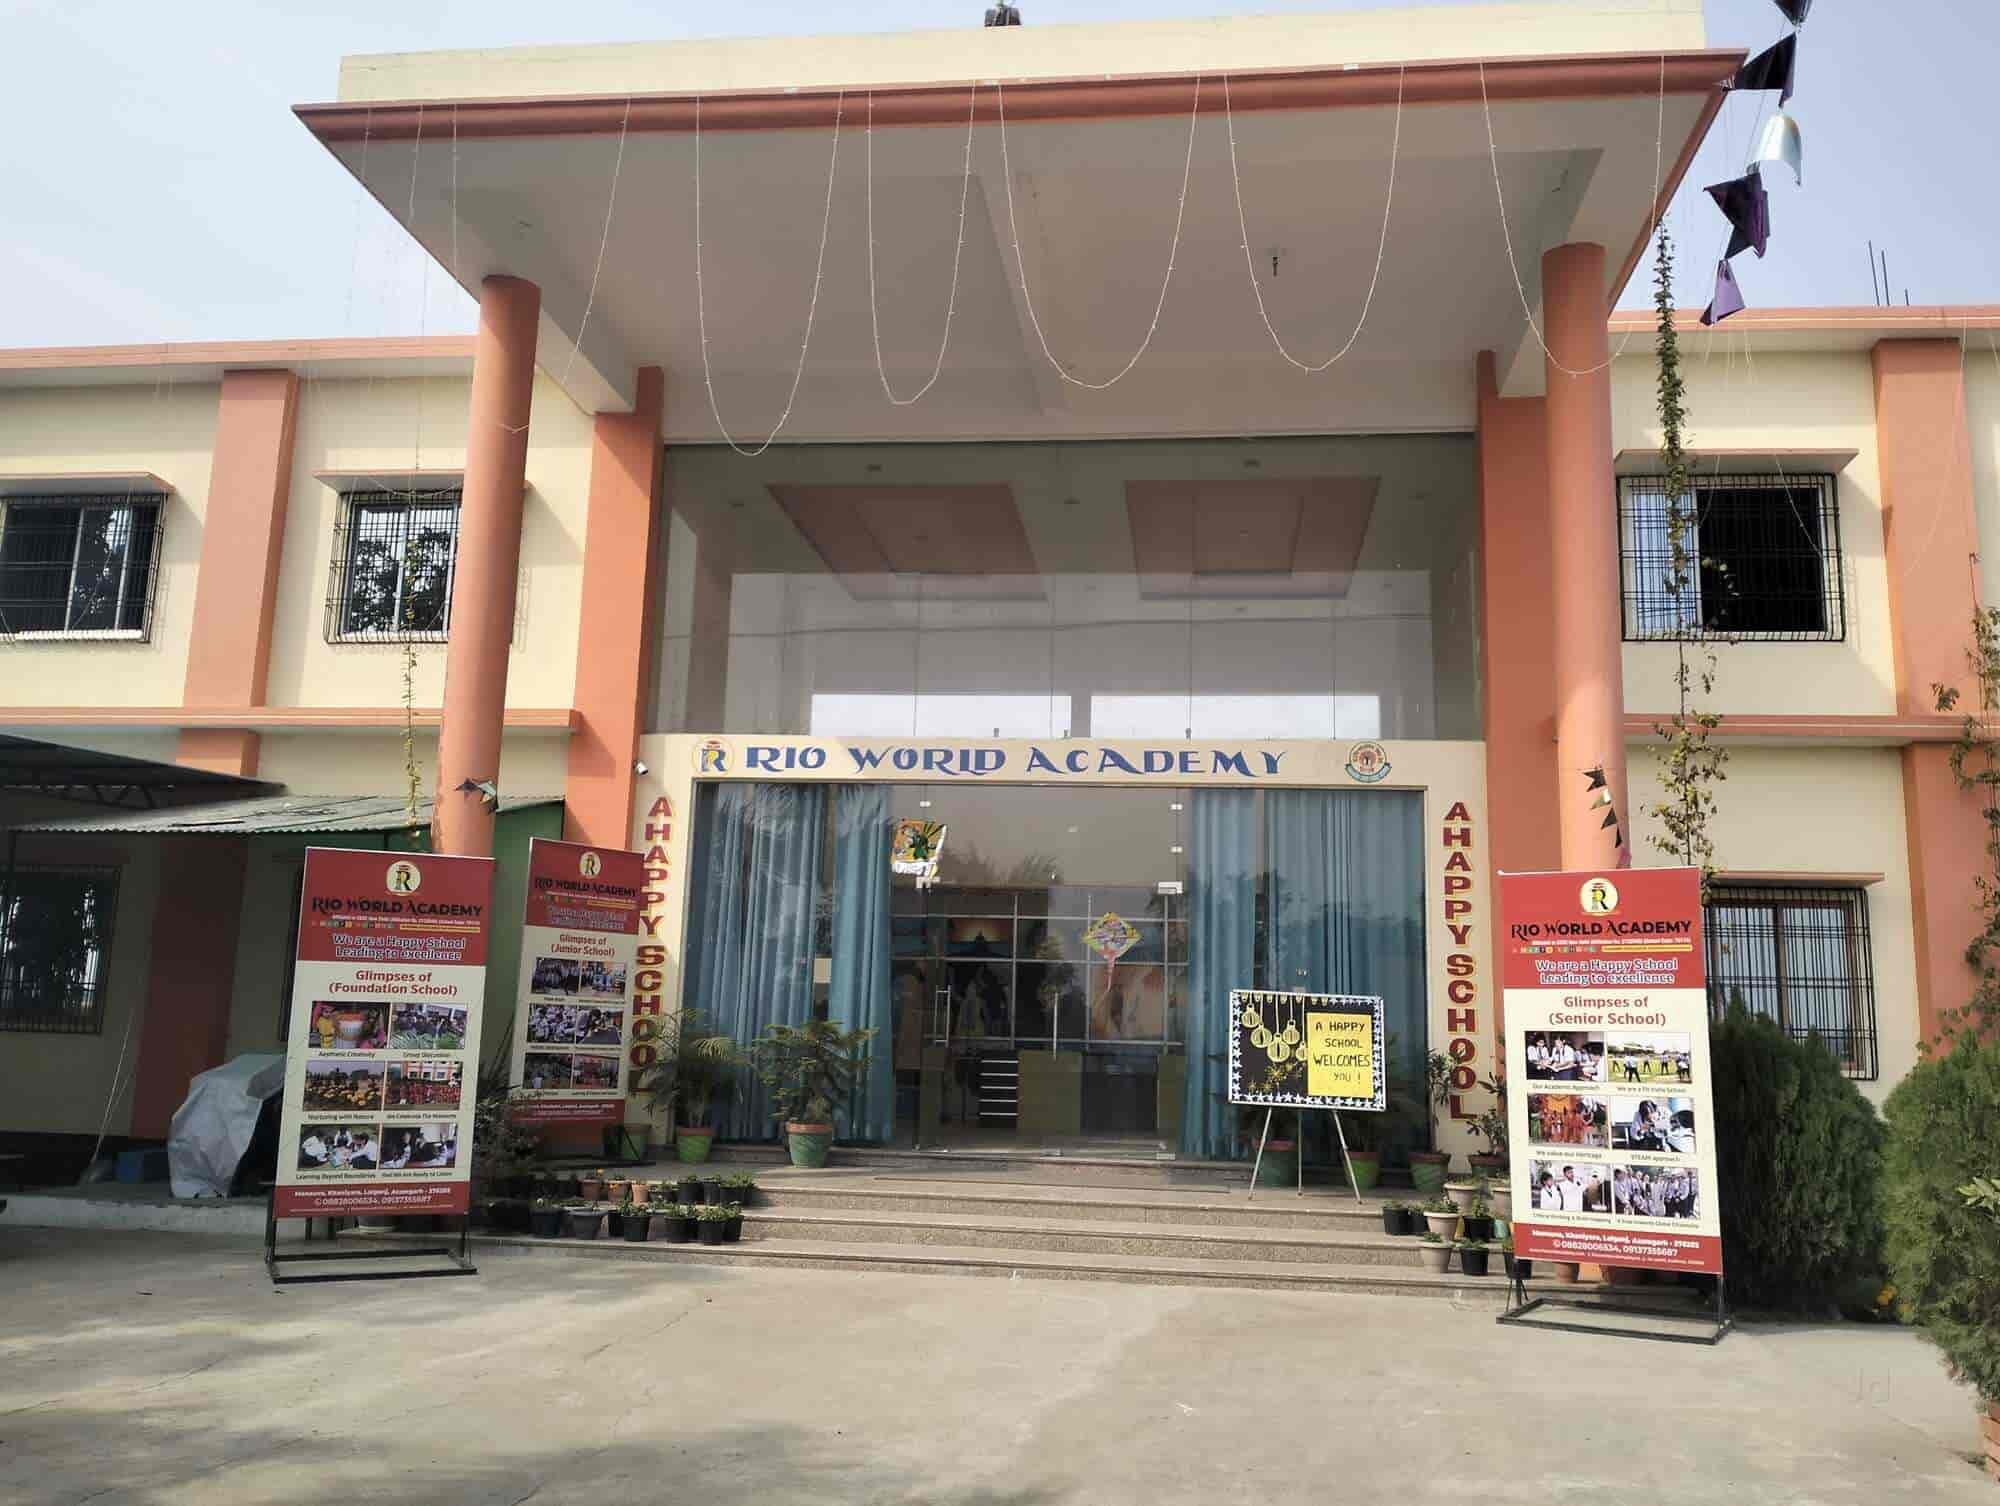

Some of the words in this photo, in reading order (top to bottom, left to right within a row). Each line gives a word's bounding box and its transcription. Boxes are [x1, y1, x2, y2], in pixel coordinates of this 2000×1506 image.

[746, 746, 827, 772] RIO
[847, 745, 1006, 775] WORLD
[1026, 746, 1289, 778] ACADEMY
[592, 883, 637, 898] ACADEMY
[312, 896, 343, 915] RIO
[346, 898, 402, 914] WORLD
[407, 900, 482, 917] ACADEMY
[1511, 923, 1541, 941] RIO
[1543, 920, 1603, 936] WORLD
[1606, 919, 1692, 937] ACADEMY
[332, 934, 352, 946] We
[354, 935, 376, 946] are
[386, 936, 425, 950] Happy
[426, 937, 466, 949] School
[559, 933, 597, 946] Glimpses
[597, 936, 608, 946] of
[335, 946, 383, 960] Leading
[384, 948, 400, 959] to
[550, 943, 581, 955] (Junior
[583, 945, 616, 957] School)
[1535, 959, 1556, 971] We
[1556, 959, 1580, 971] are
[1590, 959, 1631, 973] Happy
[1634, 957, 1679, 971] School
[355, 969, 415, 983] Glimpses
[418, 971, 432, 983] of
[1540, 972, 1590, 986] Leading
[1590, 972, 1606, 983] to
[328, 982, 408, 995] (Foundation
[411, 984, 458, 997] School)
[1563, 996, 1630, 1010] Glimpses
[1634, 996, 1649, 1008] of
[1315, 1021, 1322, 1031] A
[1329, 1021, 1365, 1033] HAPPY
[1548, 1012, 1604, 1026] (Senior
[1607, 1012, 1667, 1027] School)
[1324, 1038, 1363, 1048] SCHOOL
[1447, 953, 1478, 1120] SCHOOL
[1313, 1052, 1370, 1067] WELCOMES
